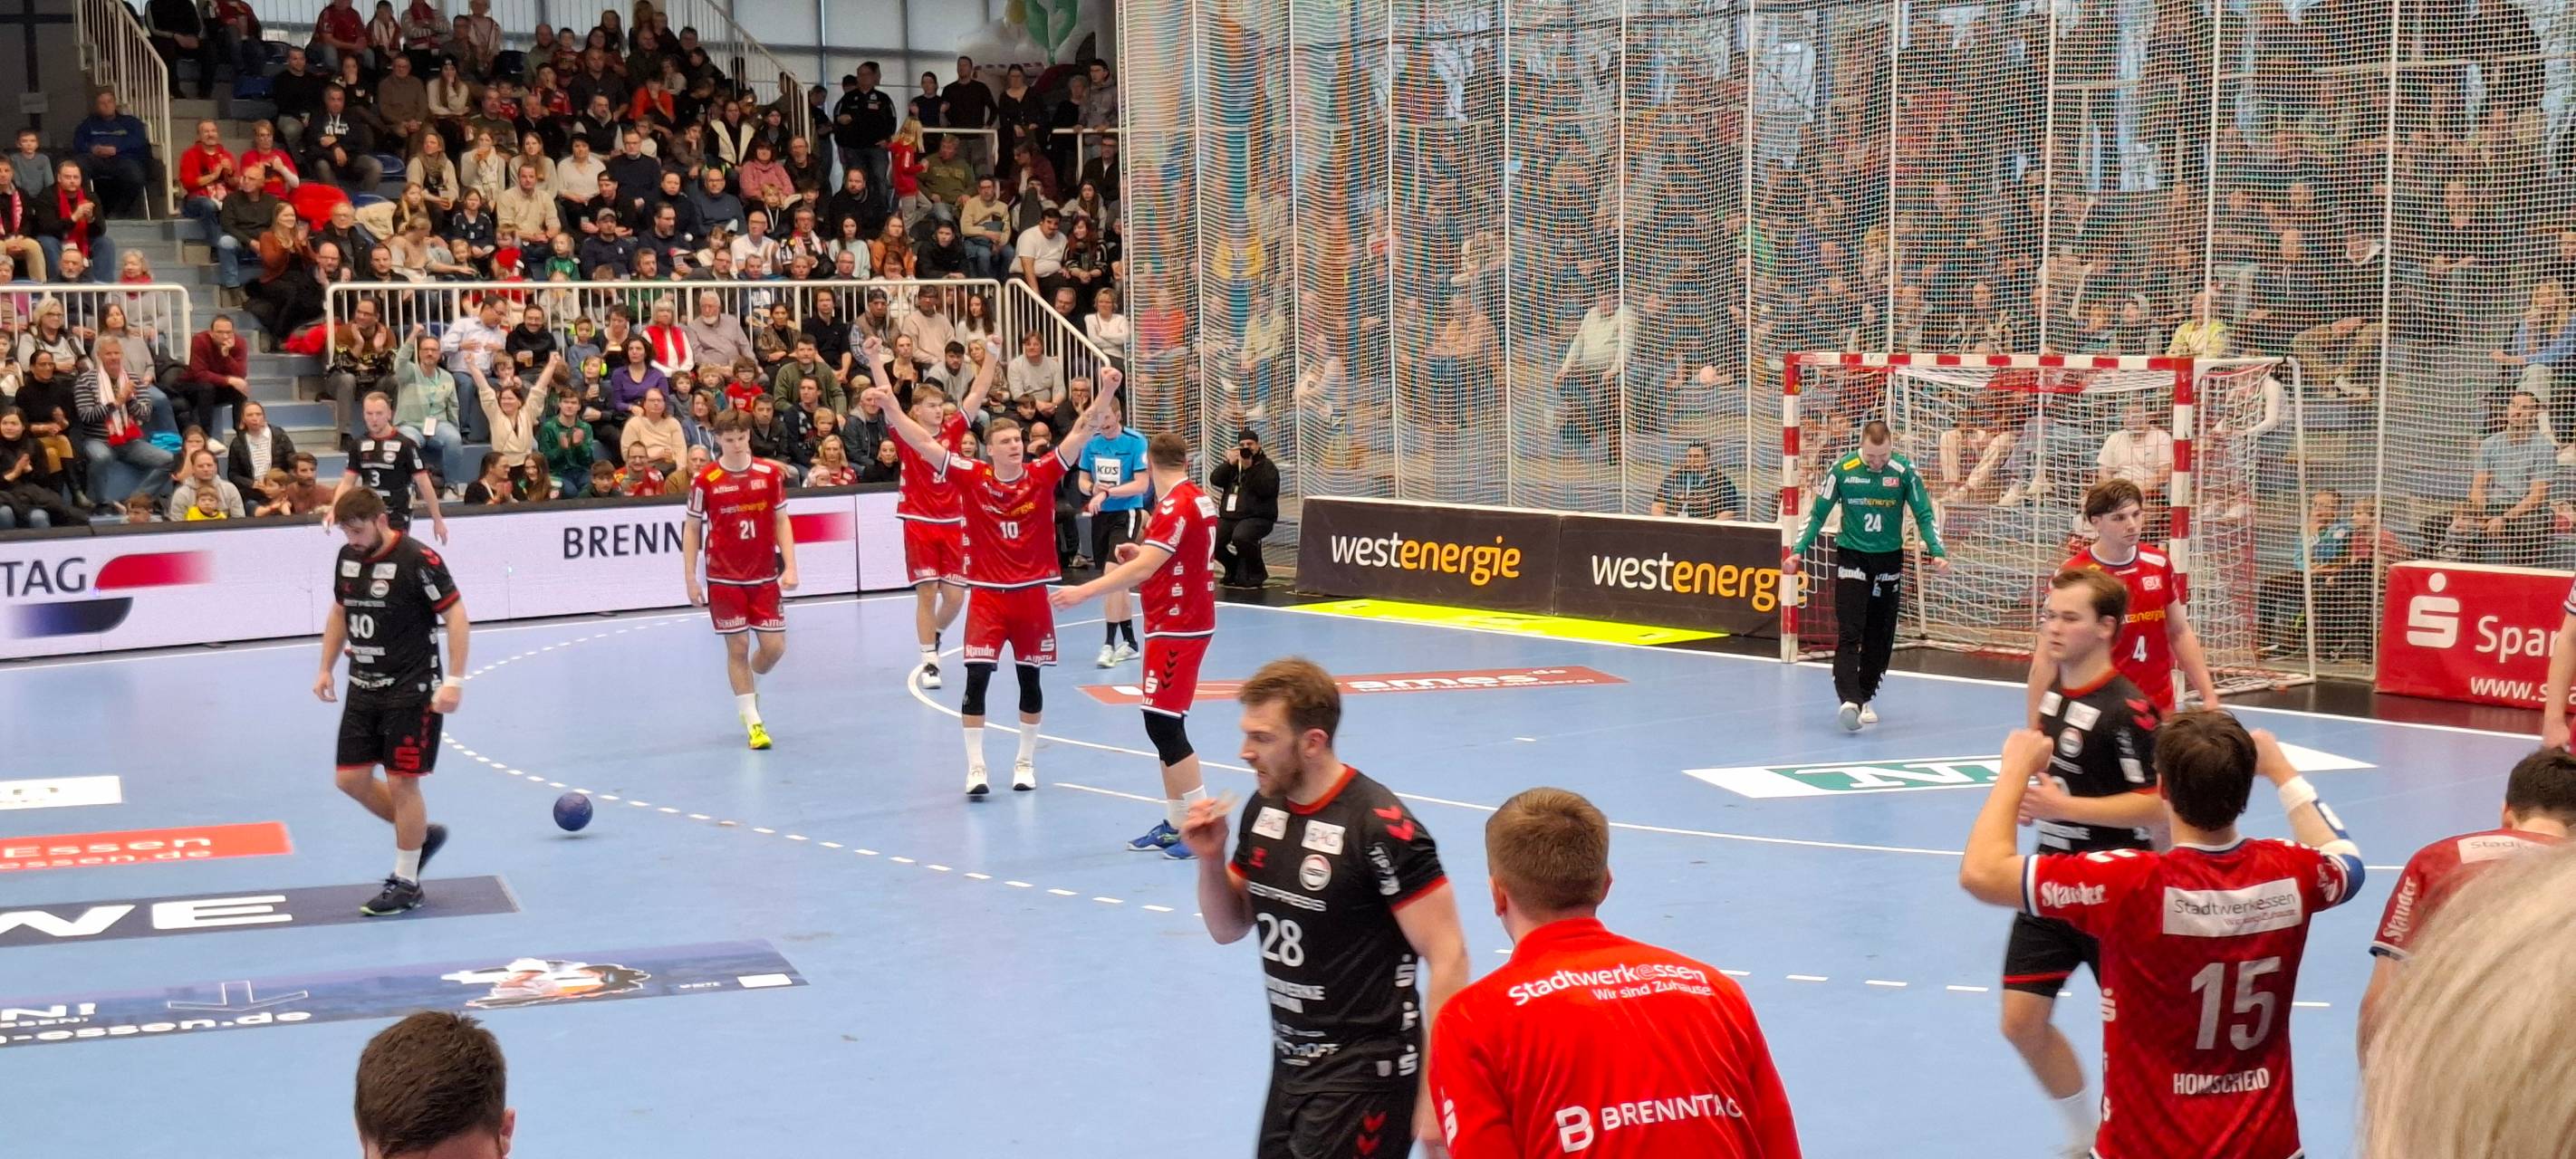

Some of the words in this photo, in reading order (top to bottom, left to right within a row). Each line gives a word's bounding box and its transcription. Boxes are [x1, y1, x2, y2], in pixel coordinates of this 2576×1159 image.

[370, 470, 380, 487] 3
[739, 521, 756, 540] 21
[1000, 522, 1019, 539] 10
[1863, 513, 1882, 532] 24
[1331, 532, 1522, 586] westenergie
[349, 613, 375, 639] 40
[2131, 636, 2148, 663] 4
[4, 838, 212, 859] Essen
[1256, 912, 1304, 967] 28
[1509, 963, 1707, 1006] Stadtwerkessen
[1592, 988, 1618, 1001] Wir
[1620, 983, 1651, 999] sind
[2190, 956, 2282, 1050] 15
[2173, 1067, 2270, 1096] HOMSCHEID
